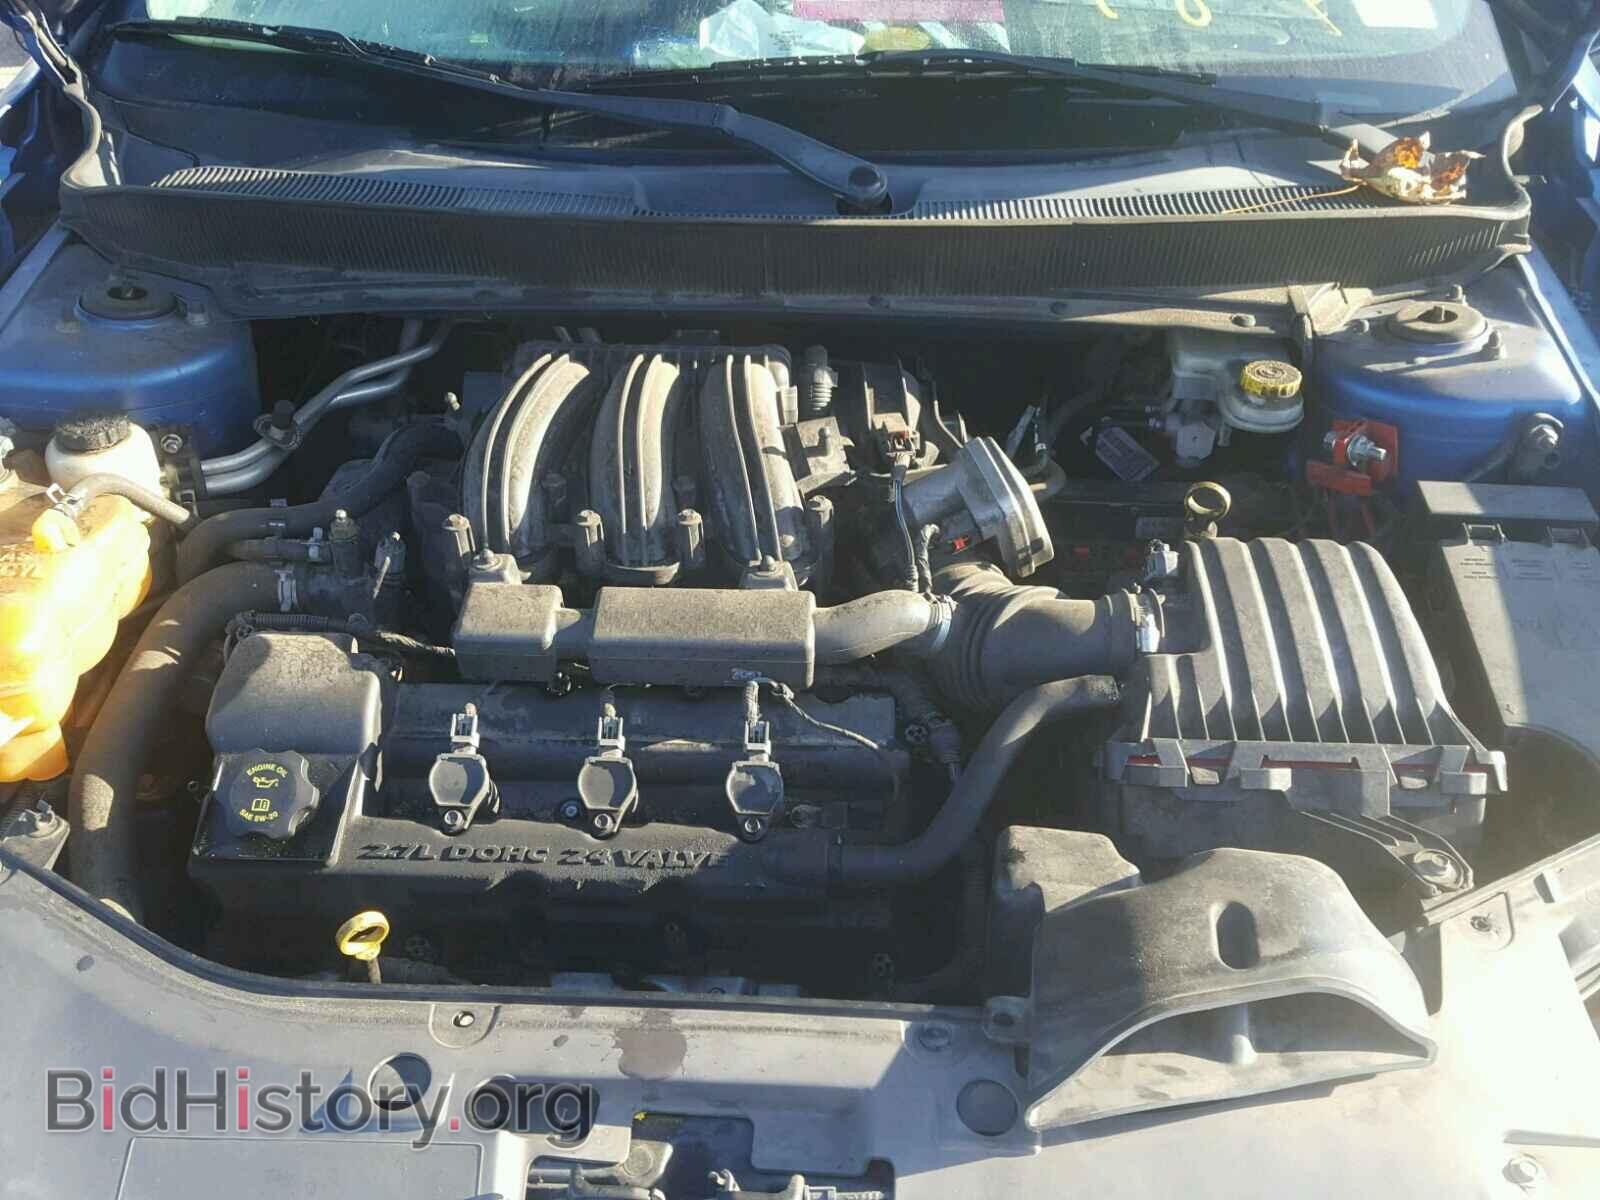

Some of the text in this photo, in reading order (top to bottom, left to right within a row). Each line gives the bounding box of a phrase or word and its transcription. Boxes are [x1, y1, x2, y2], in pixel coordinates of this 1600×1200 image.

[245, 763, 277, 777] ENGINE
[442, 844, 551, 864] DOHC
[557, 848, 613, 866] 24
